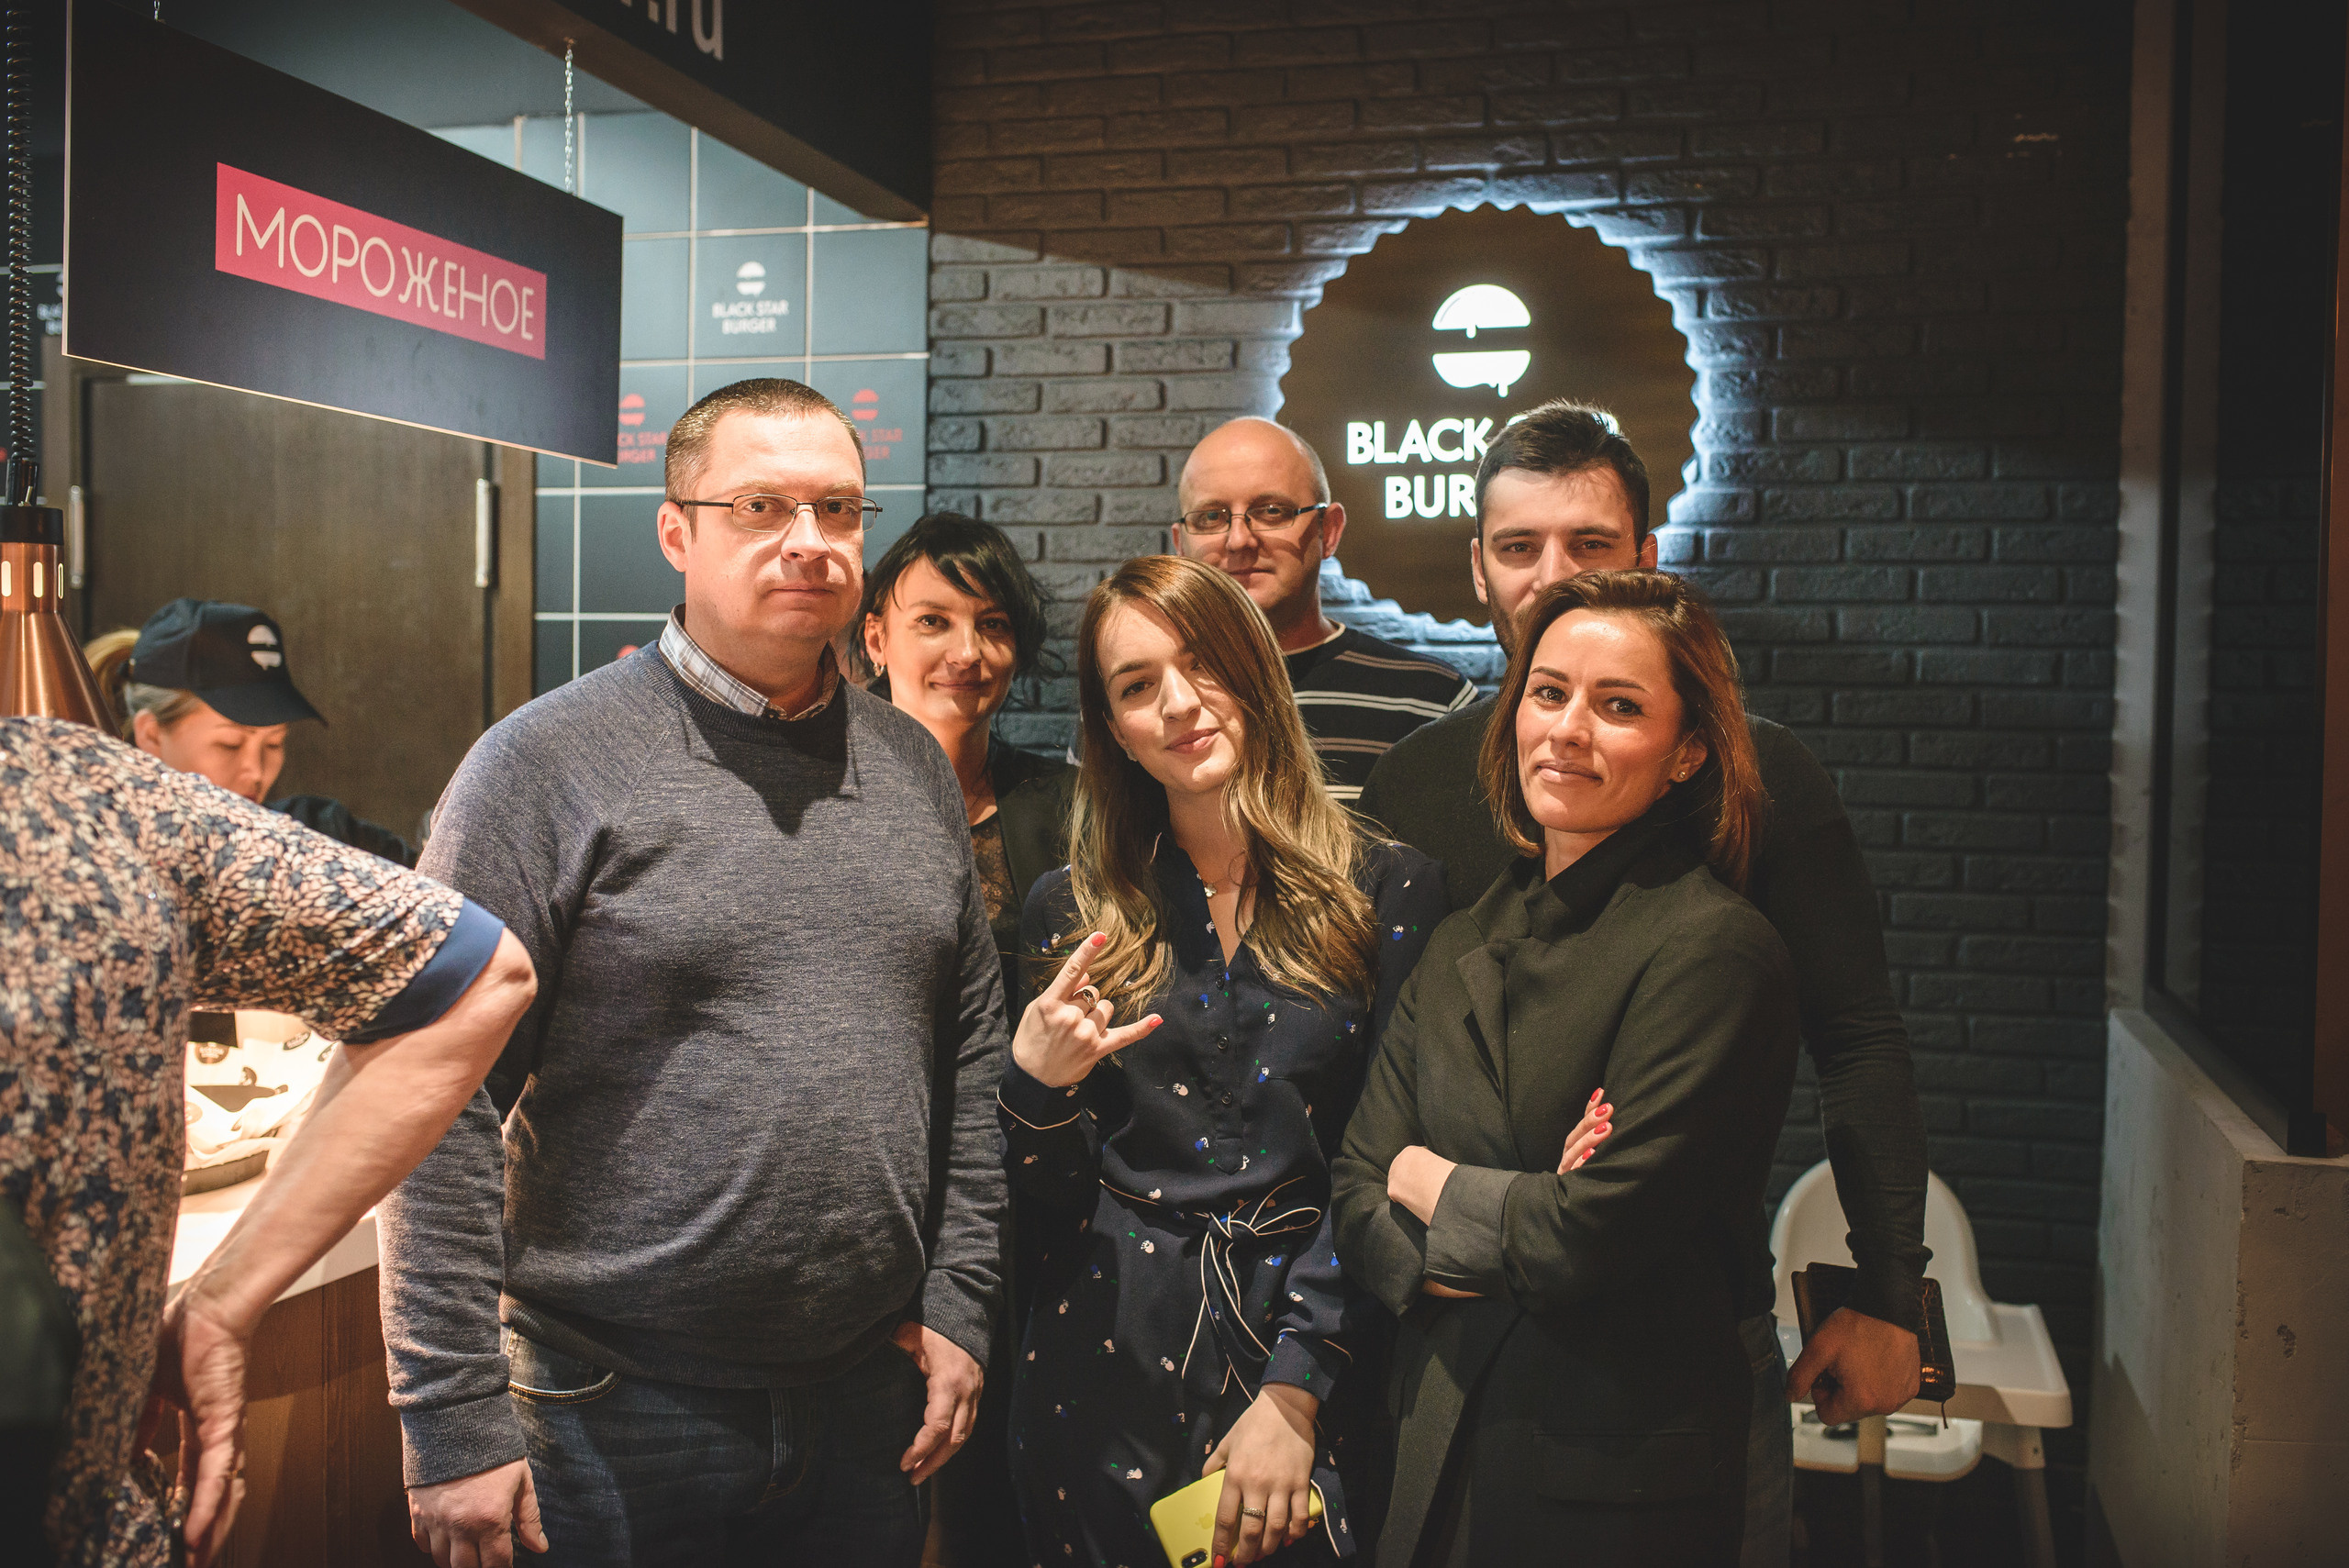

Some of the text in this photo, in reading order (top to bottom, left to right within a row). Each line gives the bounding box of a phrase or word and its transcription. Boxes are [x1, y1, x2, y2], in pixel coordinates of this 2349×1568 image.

[236, 193, 534, 341] МОРОЖЕНОЕ
[711, 300, 789, 317] BLACK STAR
[722, 317, 776, 335] BURGER
[1347, 417, 1493, 465] BLACK
[1385, 474, 1476, 519] BUR
